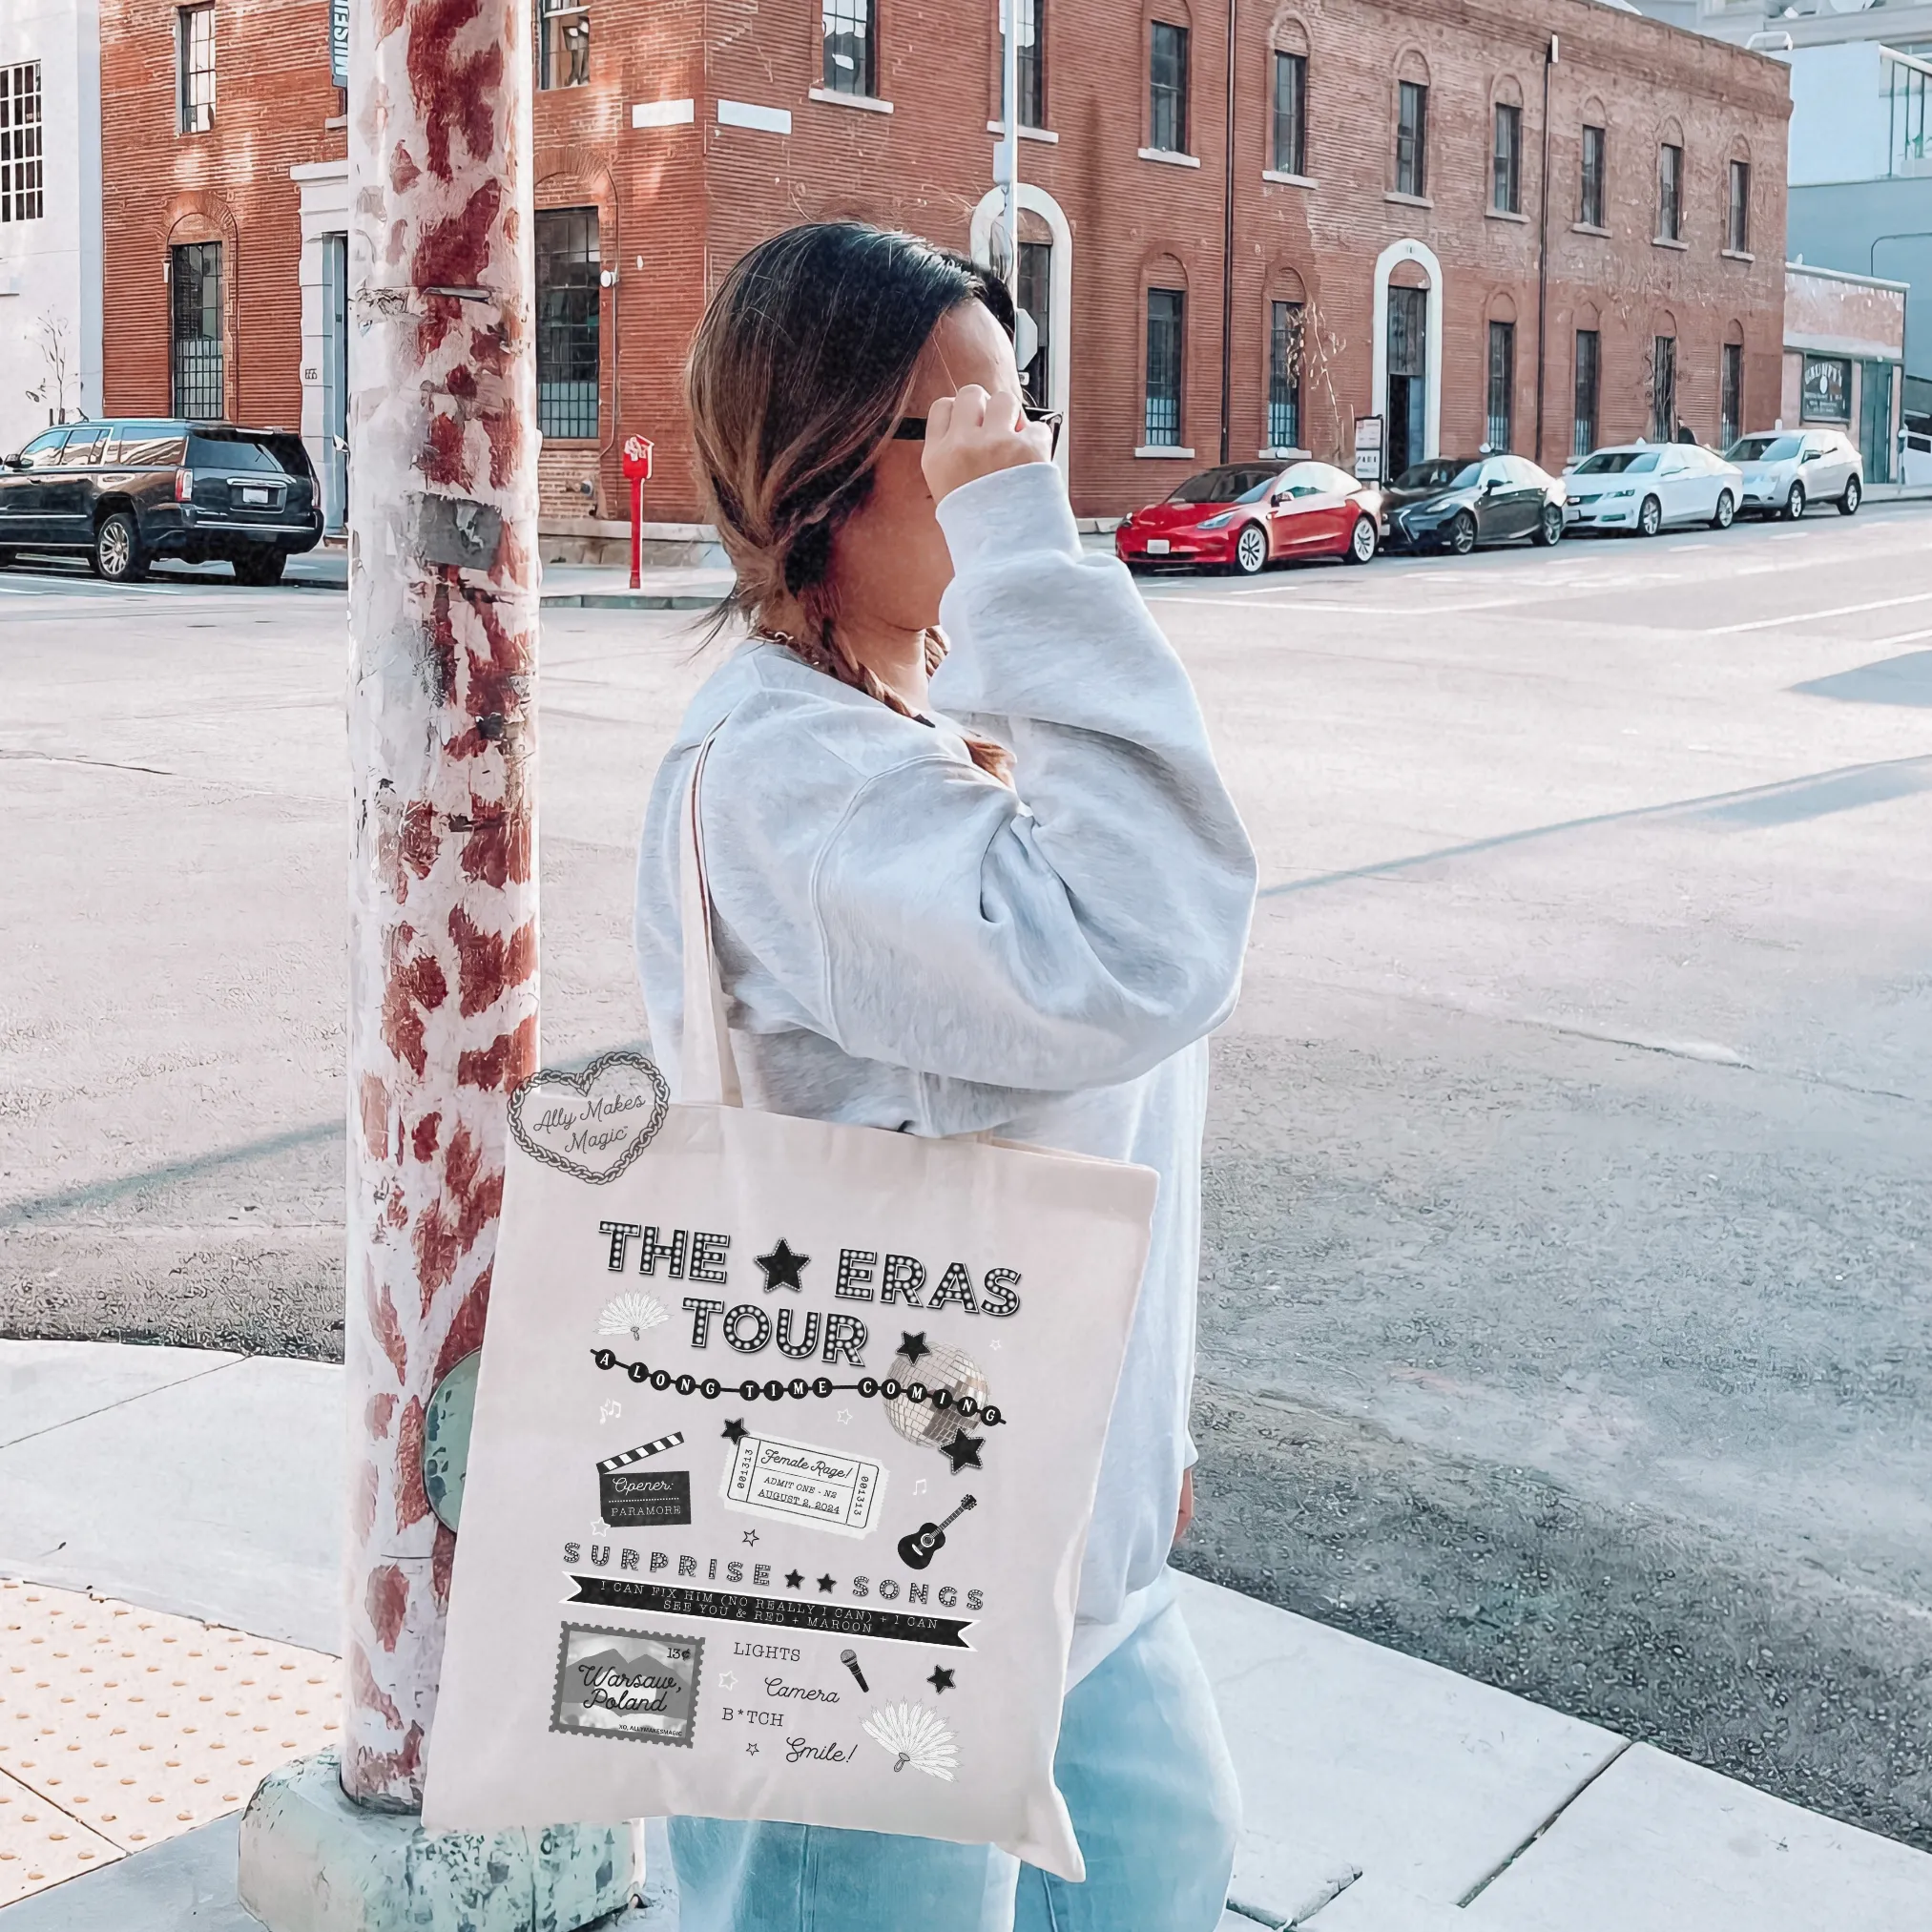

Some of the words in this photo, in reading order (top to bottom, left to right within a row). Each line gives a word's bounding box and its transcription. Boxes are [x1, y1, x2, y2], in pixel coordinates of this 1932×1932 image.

[598, 1220, 731, 1283] THE
[835, 1248, 1022, 1317] ERAS
[681, 1297, 868, 1367] TOUR
[633, 1364, 716, 1396] LONG
[745, 1380, 828, 1398] TIME
[862, 1381, 996, 1423] COMING
[737, 1448, 754, 1489] 001313
[760, 1448, 810, 1470] Female
[810, 1460, 853, 1479] Rage!
[613, 1477, 675, 1495] Opener:
[763, 1476, 794, 1489] ADMIT
[796, 1484, 816, 1494] ONE
[823, 1489, 838, 1499] N2
[854, 1476, 869, 1516] 001313
[611, 1506, 681, 1517] PARAMORE
[758, 1488, 800, 1505] AUGUST
[802, 1498, 813, 1509] 2,
[815, 1501, 841, 1514] 2024
[563, 1542, 772, 1586] SURPRISE
[852, 1575, 984, 1610] SONGS
[600, 1580, 606, 1590] I
[613, 1582, 644, 1595] CAN
[651, 1587, 677, 1599] FIX
[684, 1590, 714, 1603] HIM
[720, 1594, 748, 1607] (NO
[756, 1598, 816, 1615] REALLY
[821, 1606, 827, 1616] I
[834, 1608, 873, 1623] CAN)
[894, 1614, 900, 1625] I
[907, 1616, 938, 1630] CAN
[663, 1600, 692, 1612] SEE
[698, 1604, 729, 1616] YOU
[736, 1608, 747, 1618] &
[754, 1610, 785, 1623] RED
[807, 1616, 873, 1633] MAROON
[667, 1647, 691, 1661] 13¢
[733, 1641, 801, 1662] LIGHTS
[578, 1664, 682, 1693] Warsaw,
[764, 1677, 841, 1703] Camera
[583, 1688, 668, 1712] Poland
[629, 1725, 683, 1736] ALLYMAKESMAGIC
[785, 1736, 859, 1763] Smile!
